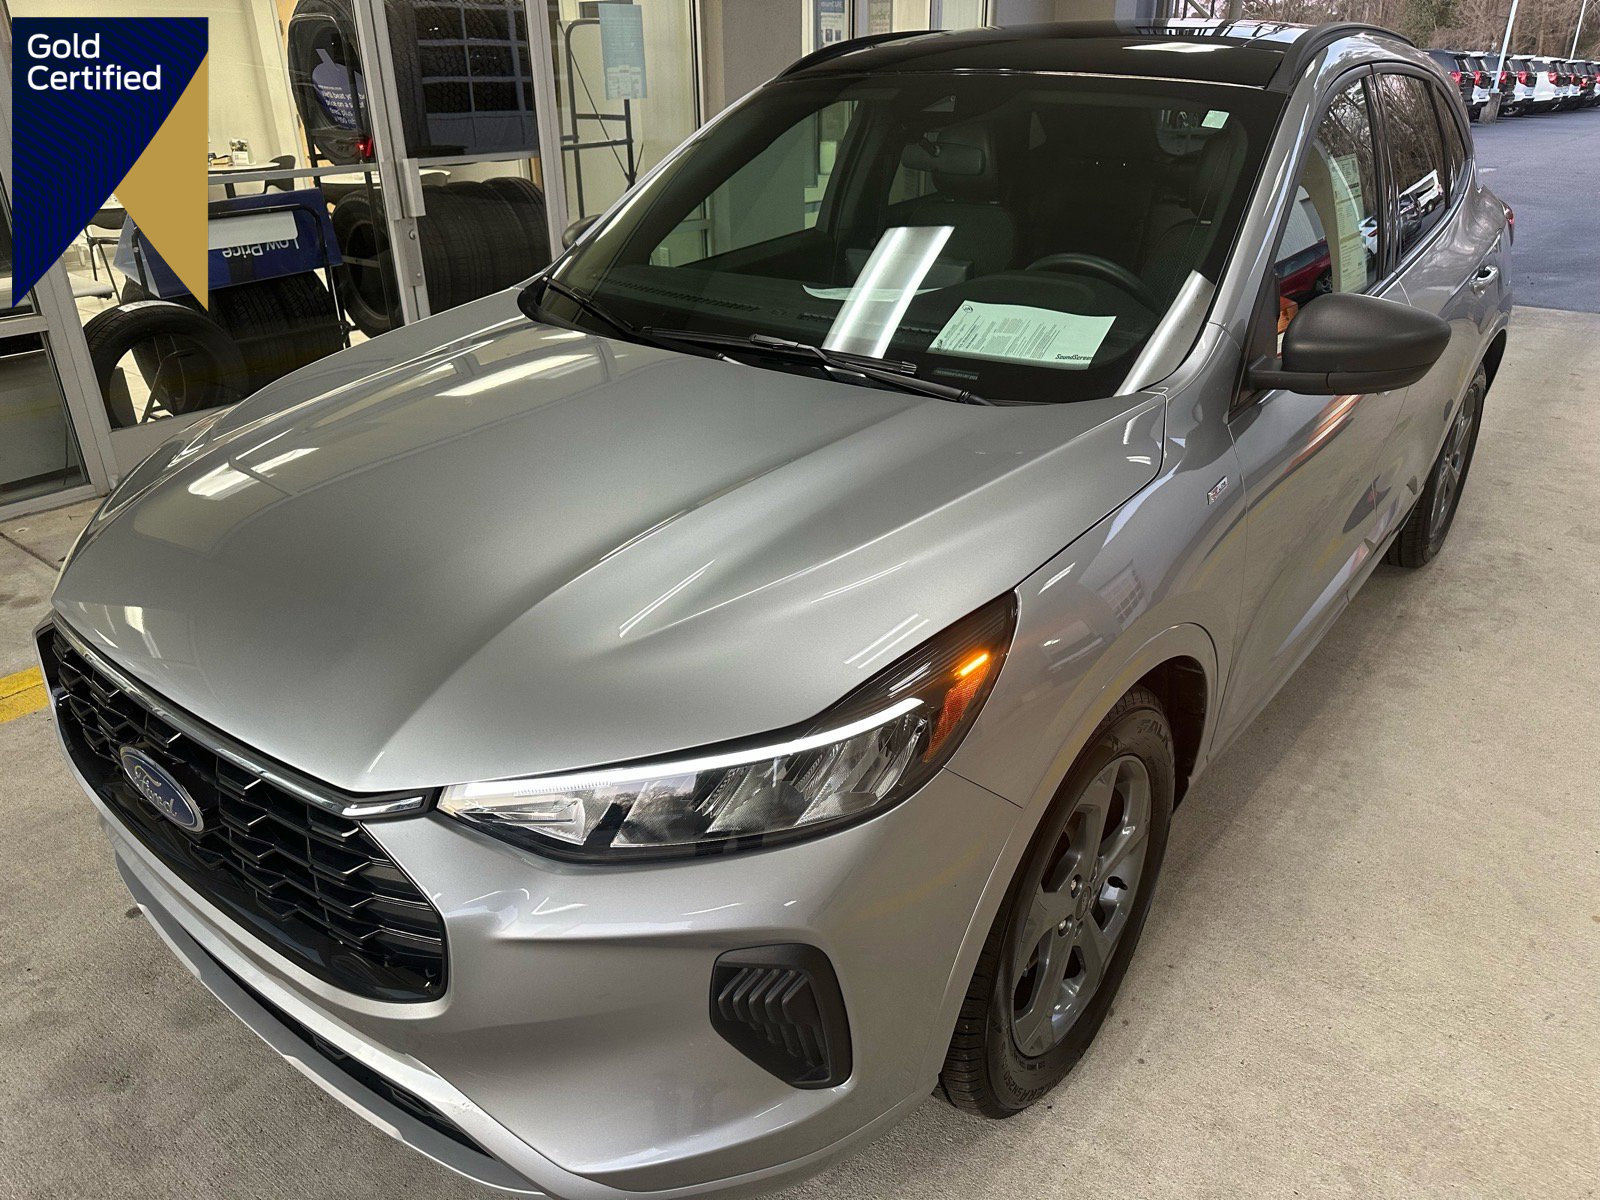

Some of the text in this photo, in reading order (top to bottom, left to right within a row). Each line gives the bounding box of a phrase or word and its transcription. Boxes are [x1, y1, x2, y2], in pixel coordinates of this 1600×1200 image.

[222, 238, 300, 259] Low Price
[134, 764, 178, 817] Ford
